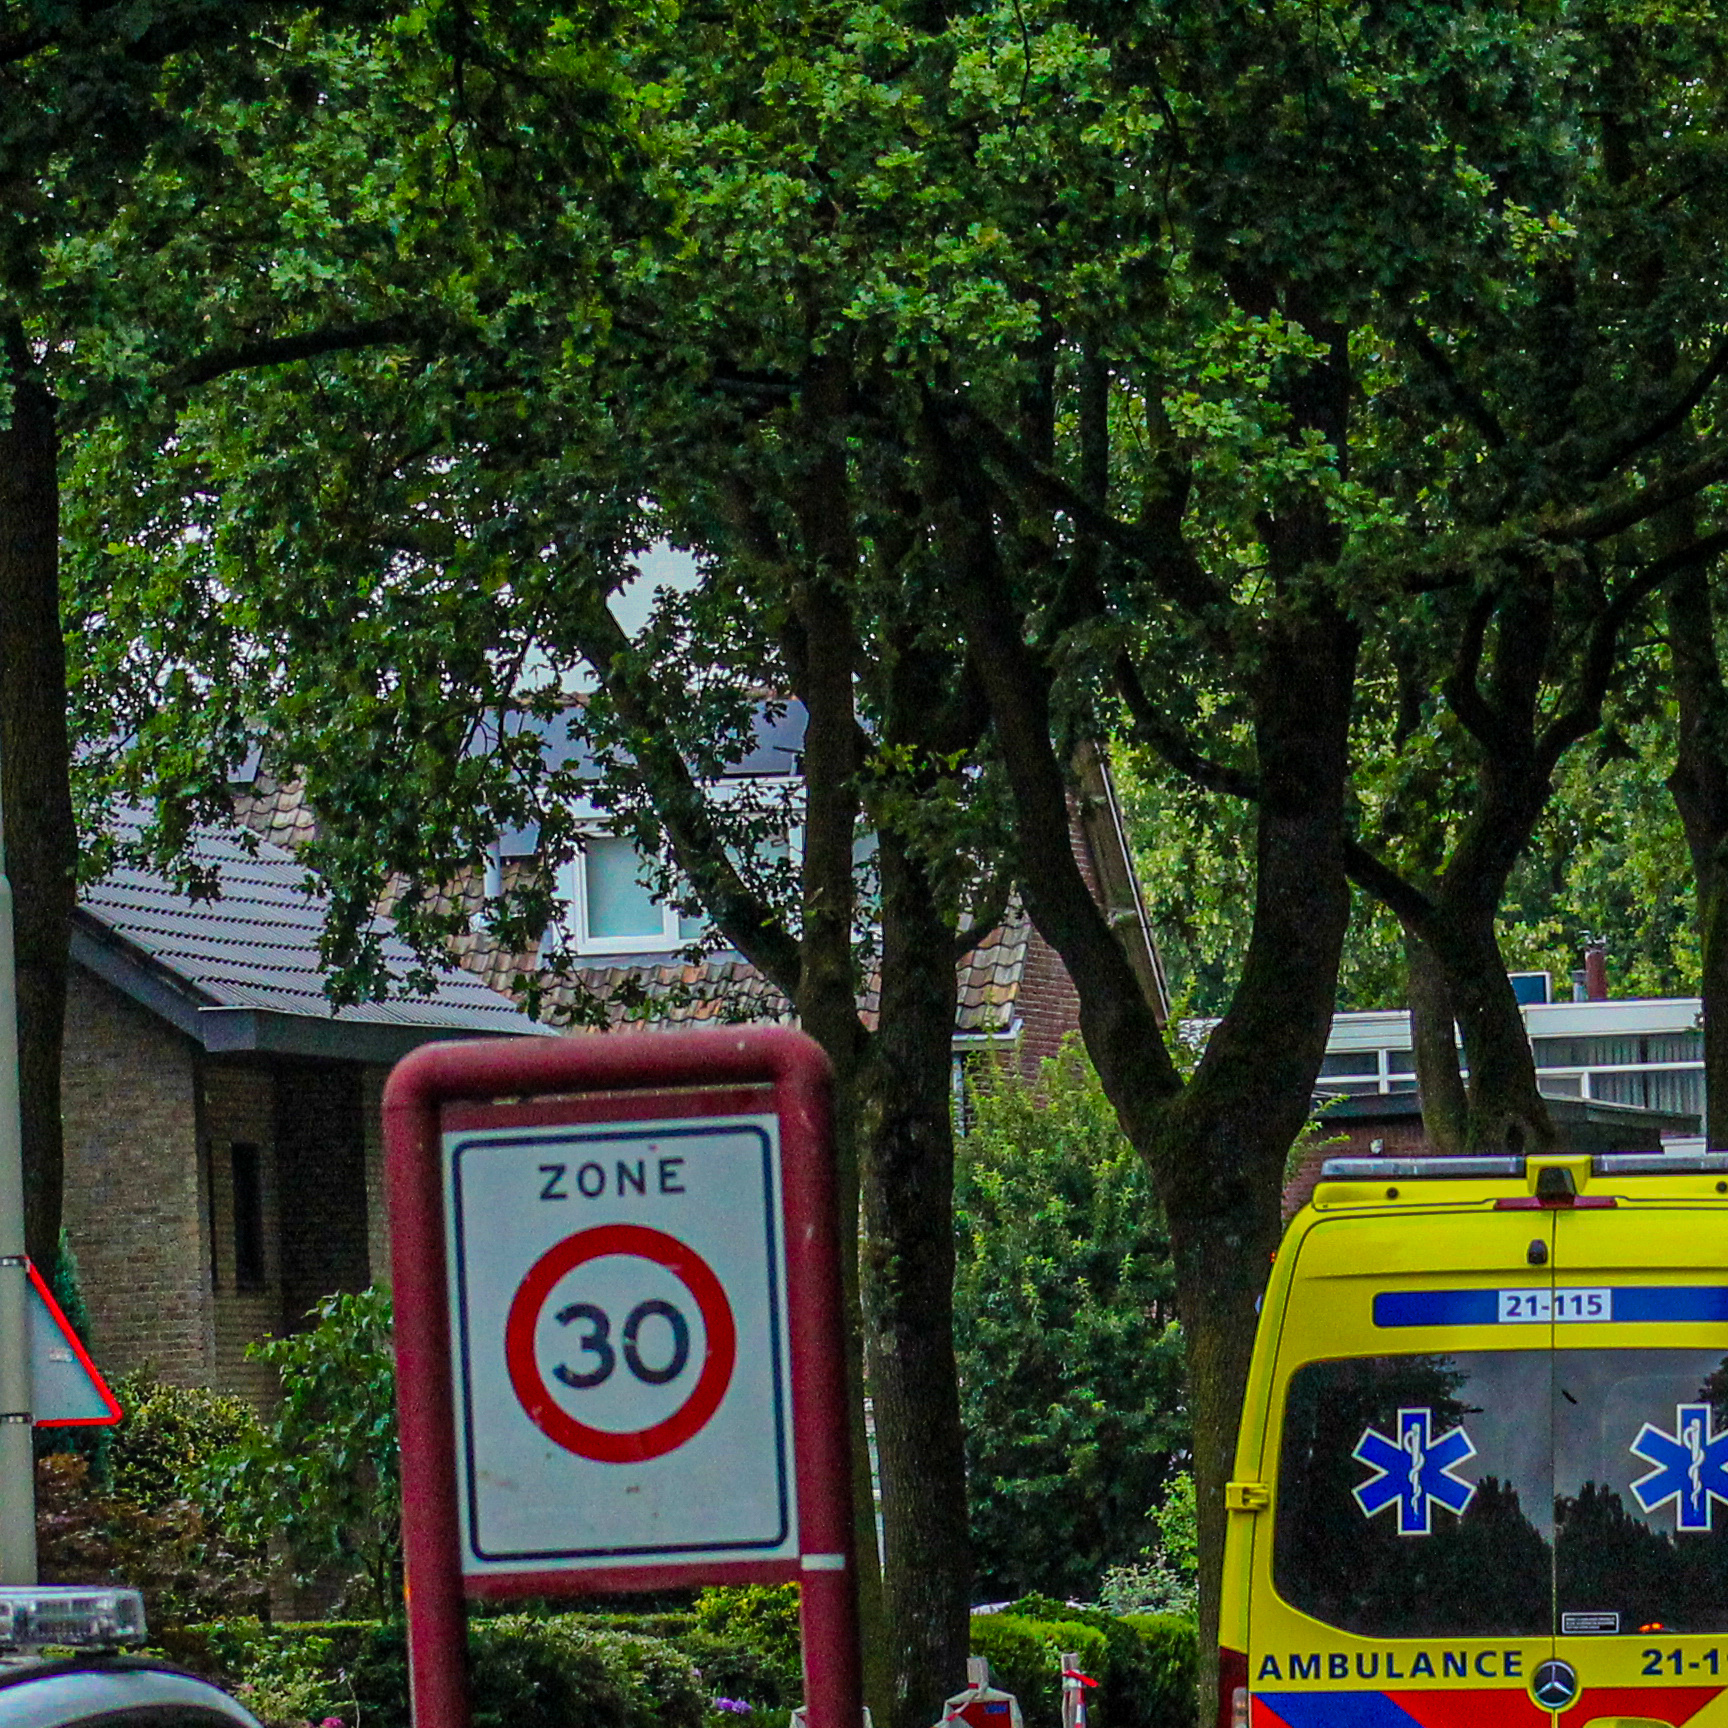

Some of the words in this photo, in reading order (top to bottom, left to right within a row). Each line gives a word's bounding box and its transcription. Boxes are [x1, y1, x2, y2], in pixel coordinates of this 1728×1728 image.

[538, 1157, 687, 1202] ZONE
[1505, 1293, 1603, 1318] 21-115
[551, 1299, 692, 1390] 30
[1257, 1650, 1523, 1681] AMBULANCE
